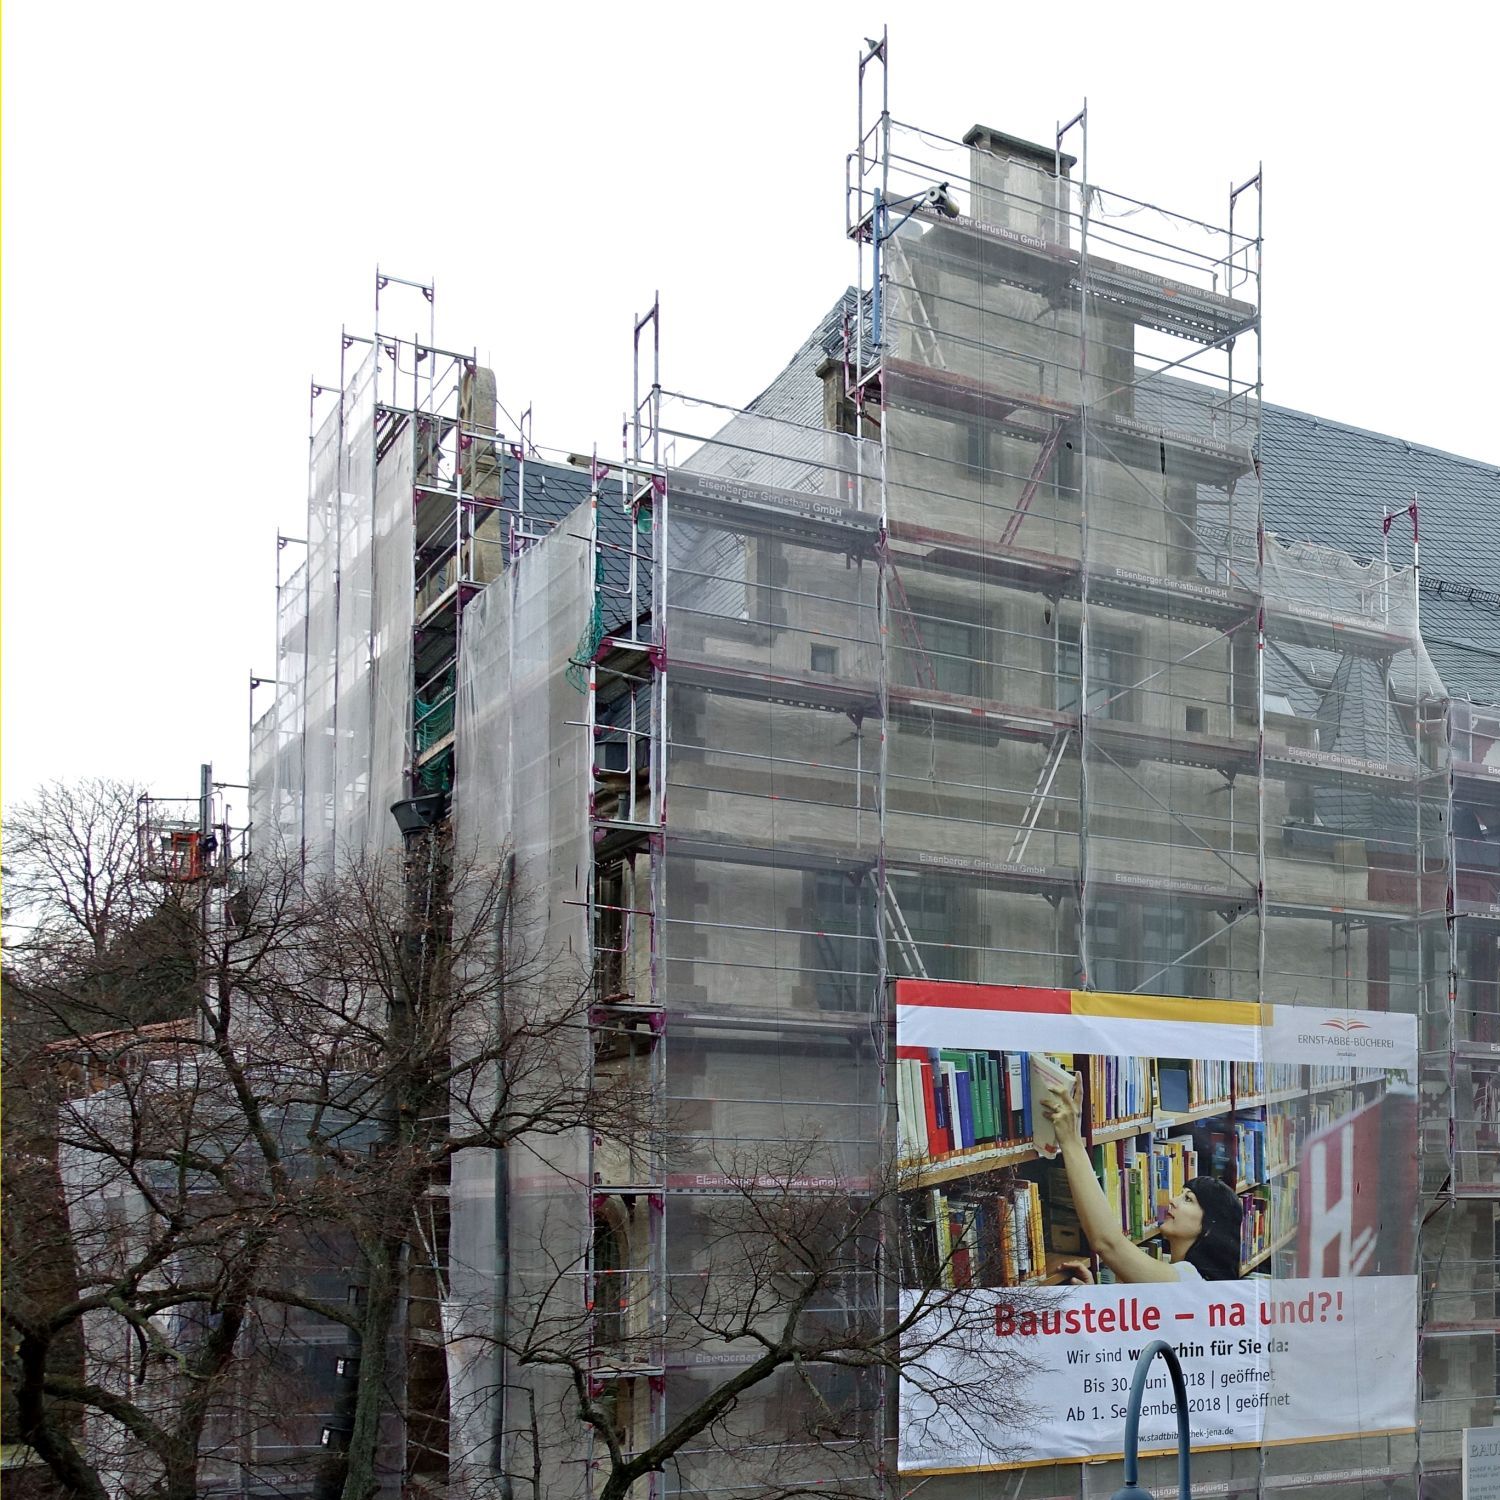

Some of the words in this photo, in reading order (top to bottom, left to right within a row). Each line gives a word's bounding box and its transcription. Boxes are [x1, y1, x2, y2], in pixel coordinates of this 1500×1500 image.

[1020, 234, 1047, 249] GmbH
[698, 477, 757, 498] Eisenberger
[812, 503, 842, 517] GmbH
[1116, 568, 1163, 584] Eisenberger
[1204, 586, 1228, 598] GmbH
[1288, 746, 1330, 762] Eisenberger
[1367, 760, 1388, 770] GmbH
[1020, 864, 1046, 874] GmbH
[994, 1298, 1161, 1337] Baustelle
[1208, 1302, 1246, 1327] na
[1259, 1291, 1343, 1325] und?!
[1067, 1348, 1090, 1364] Wir
[1095, 1347, 1122, 1363] sind
[1210, 1340, 1234, 1356] für
[1238, 1338, 1262, 1354] Sie
[1083, 1378, 1105, 1393] Bis
[1111, 1376, 1132, 1392] 30.
[1145, 1373, 1167, 1389] uni
[1181, 1372, 1206, 1387] 018
[1220, 1368, 1276, 1388] geöffnet
[1066, 1407, 1085, 1421] Ab
[1091, 1406, 1105, 1420] 1.
[1110, 1400, 1178, 1419] Seembe
[1188, 1397, 1221, 1413] 2018
[1235, 1392, 1291, 1413] geöffnet
[1190, 1482, 1229, 1493] Eisenberg
